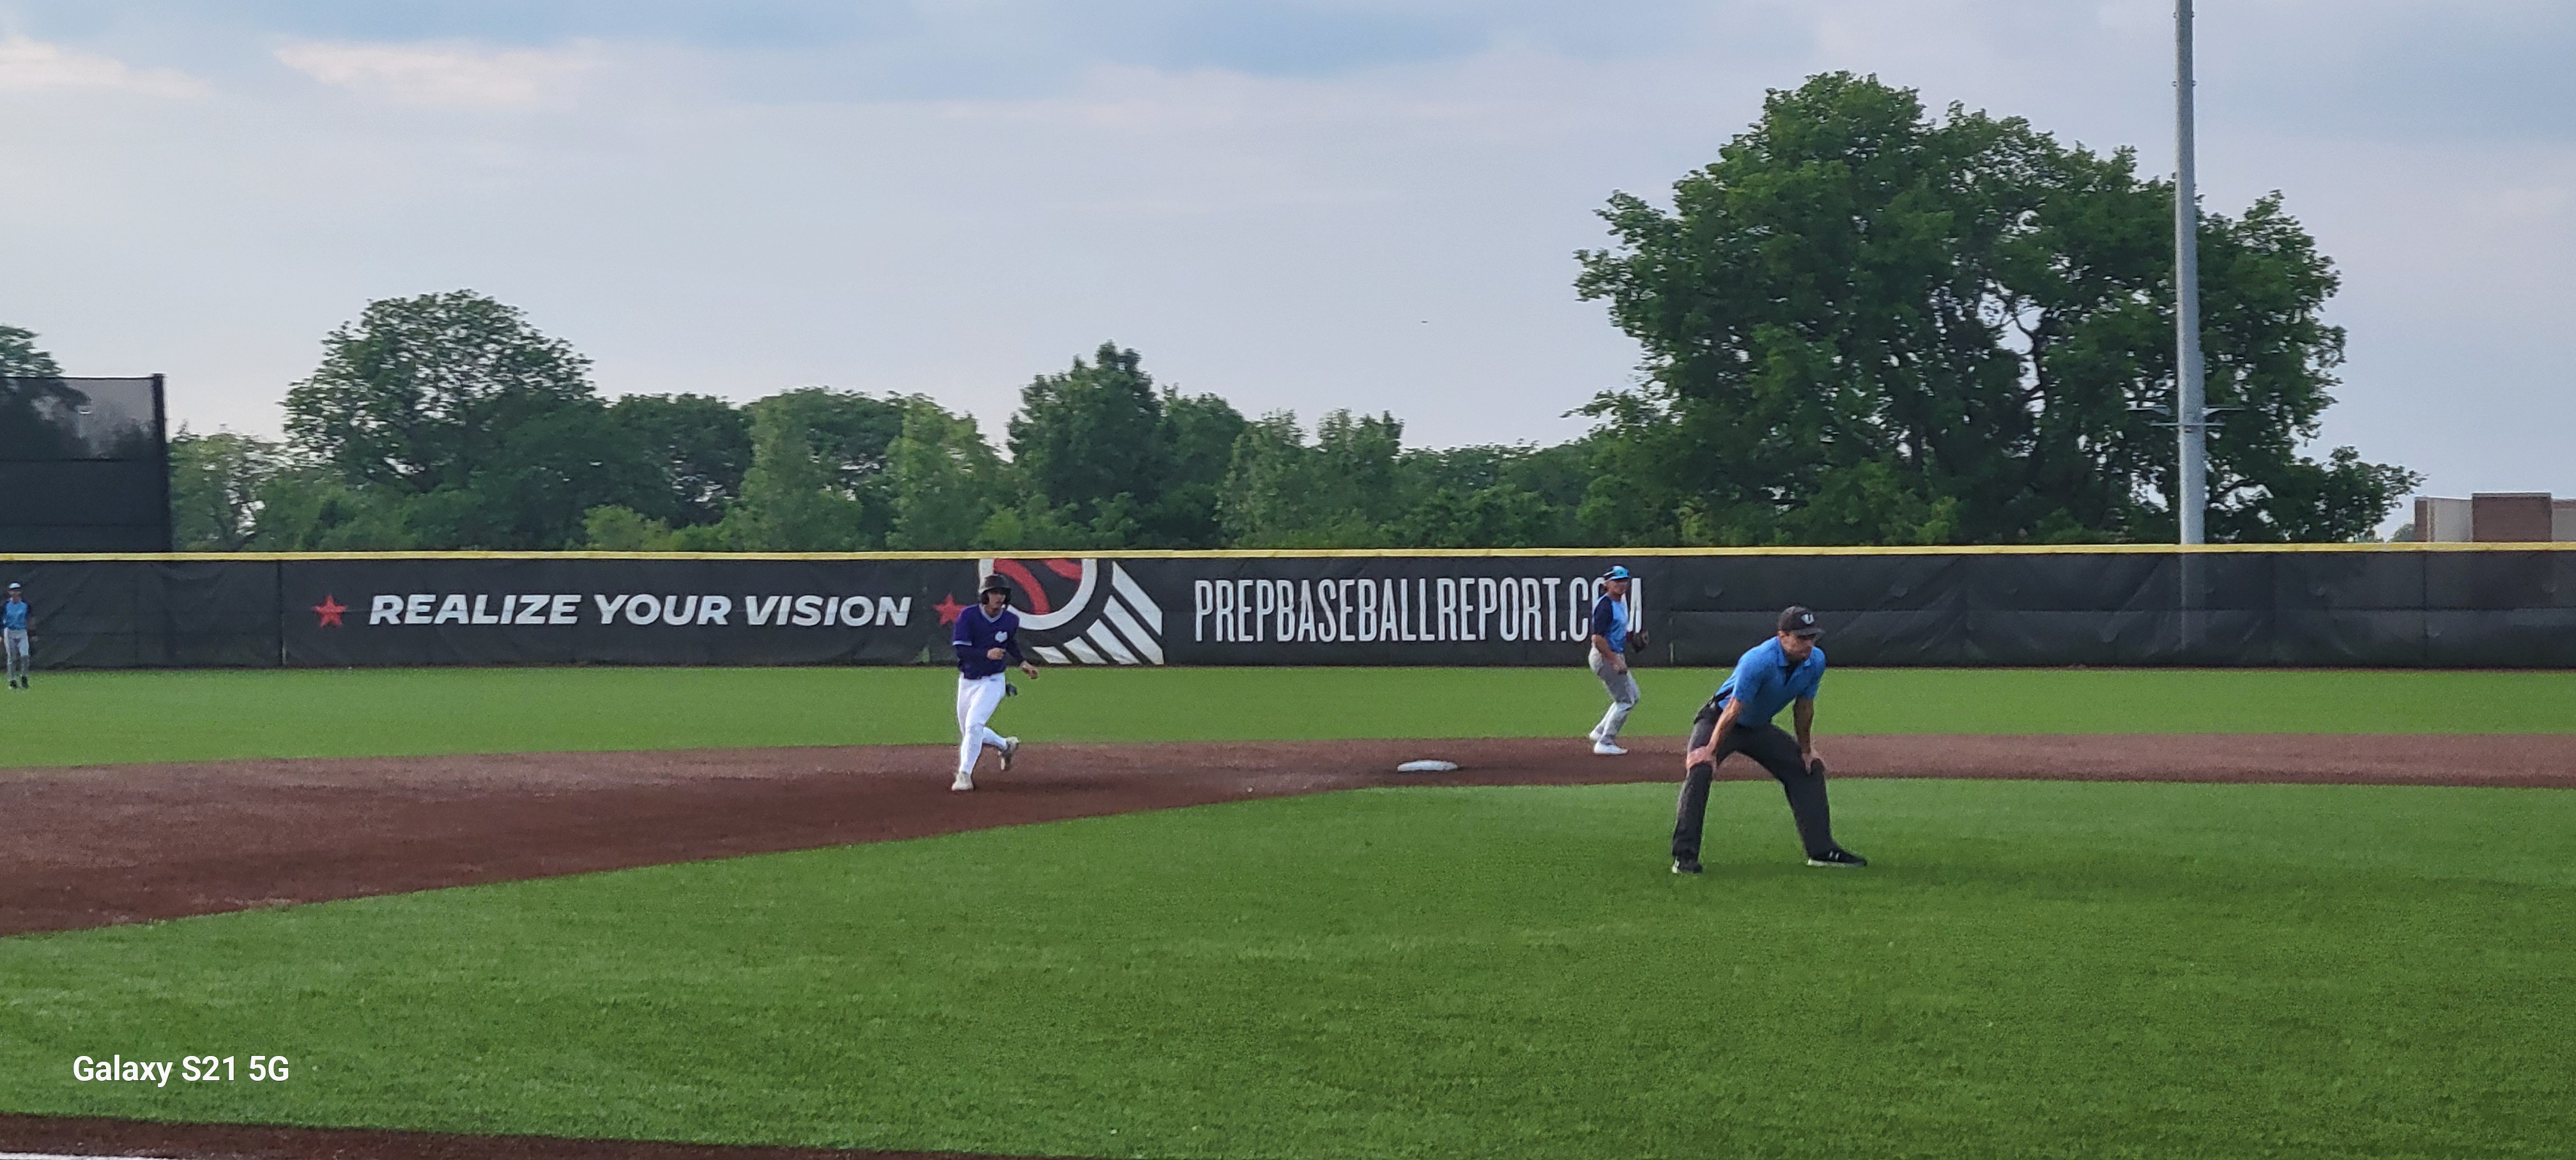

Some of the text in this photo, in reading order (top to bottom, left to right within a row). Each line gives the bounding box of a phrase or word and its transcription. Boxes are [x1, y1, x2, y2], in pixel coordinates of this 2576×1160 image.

[369, 594, 912, 627] REALIZE YOUR VISION
[1194, 577, 1643, 643] PREPBASEBALLREPORT.CM
